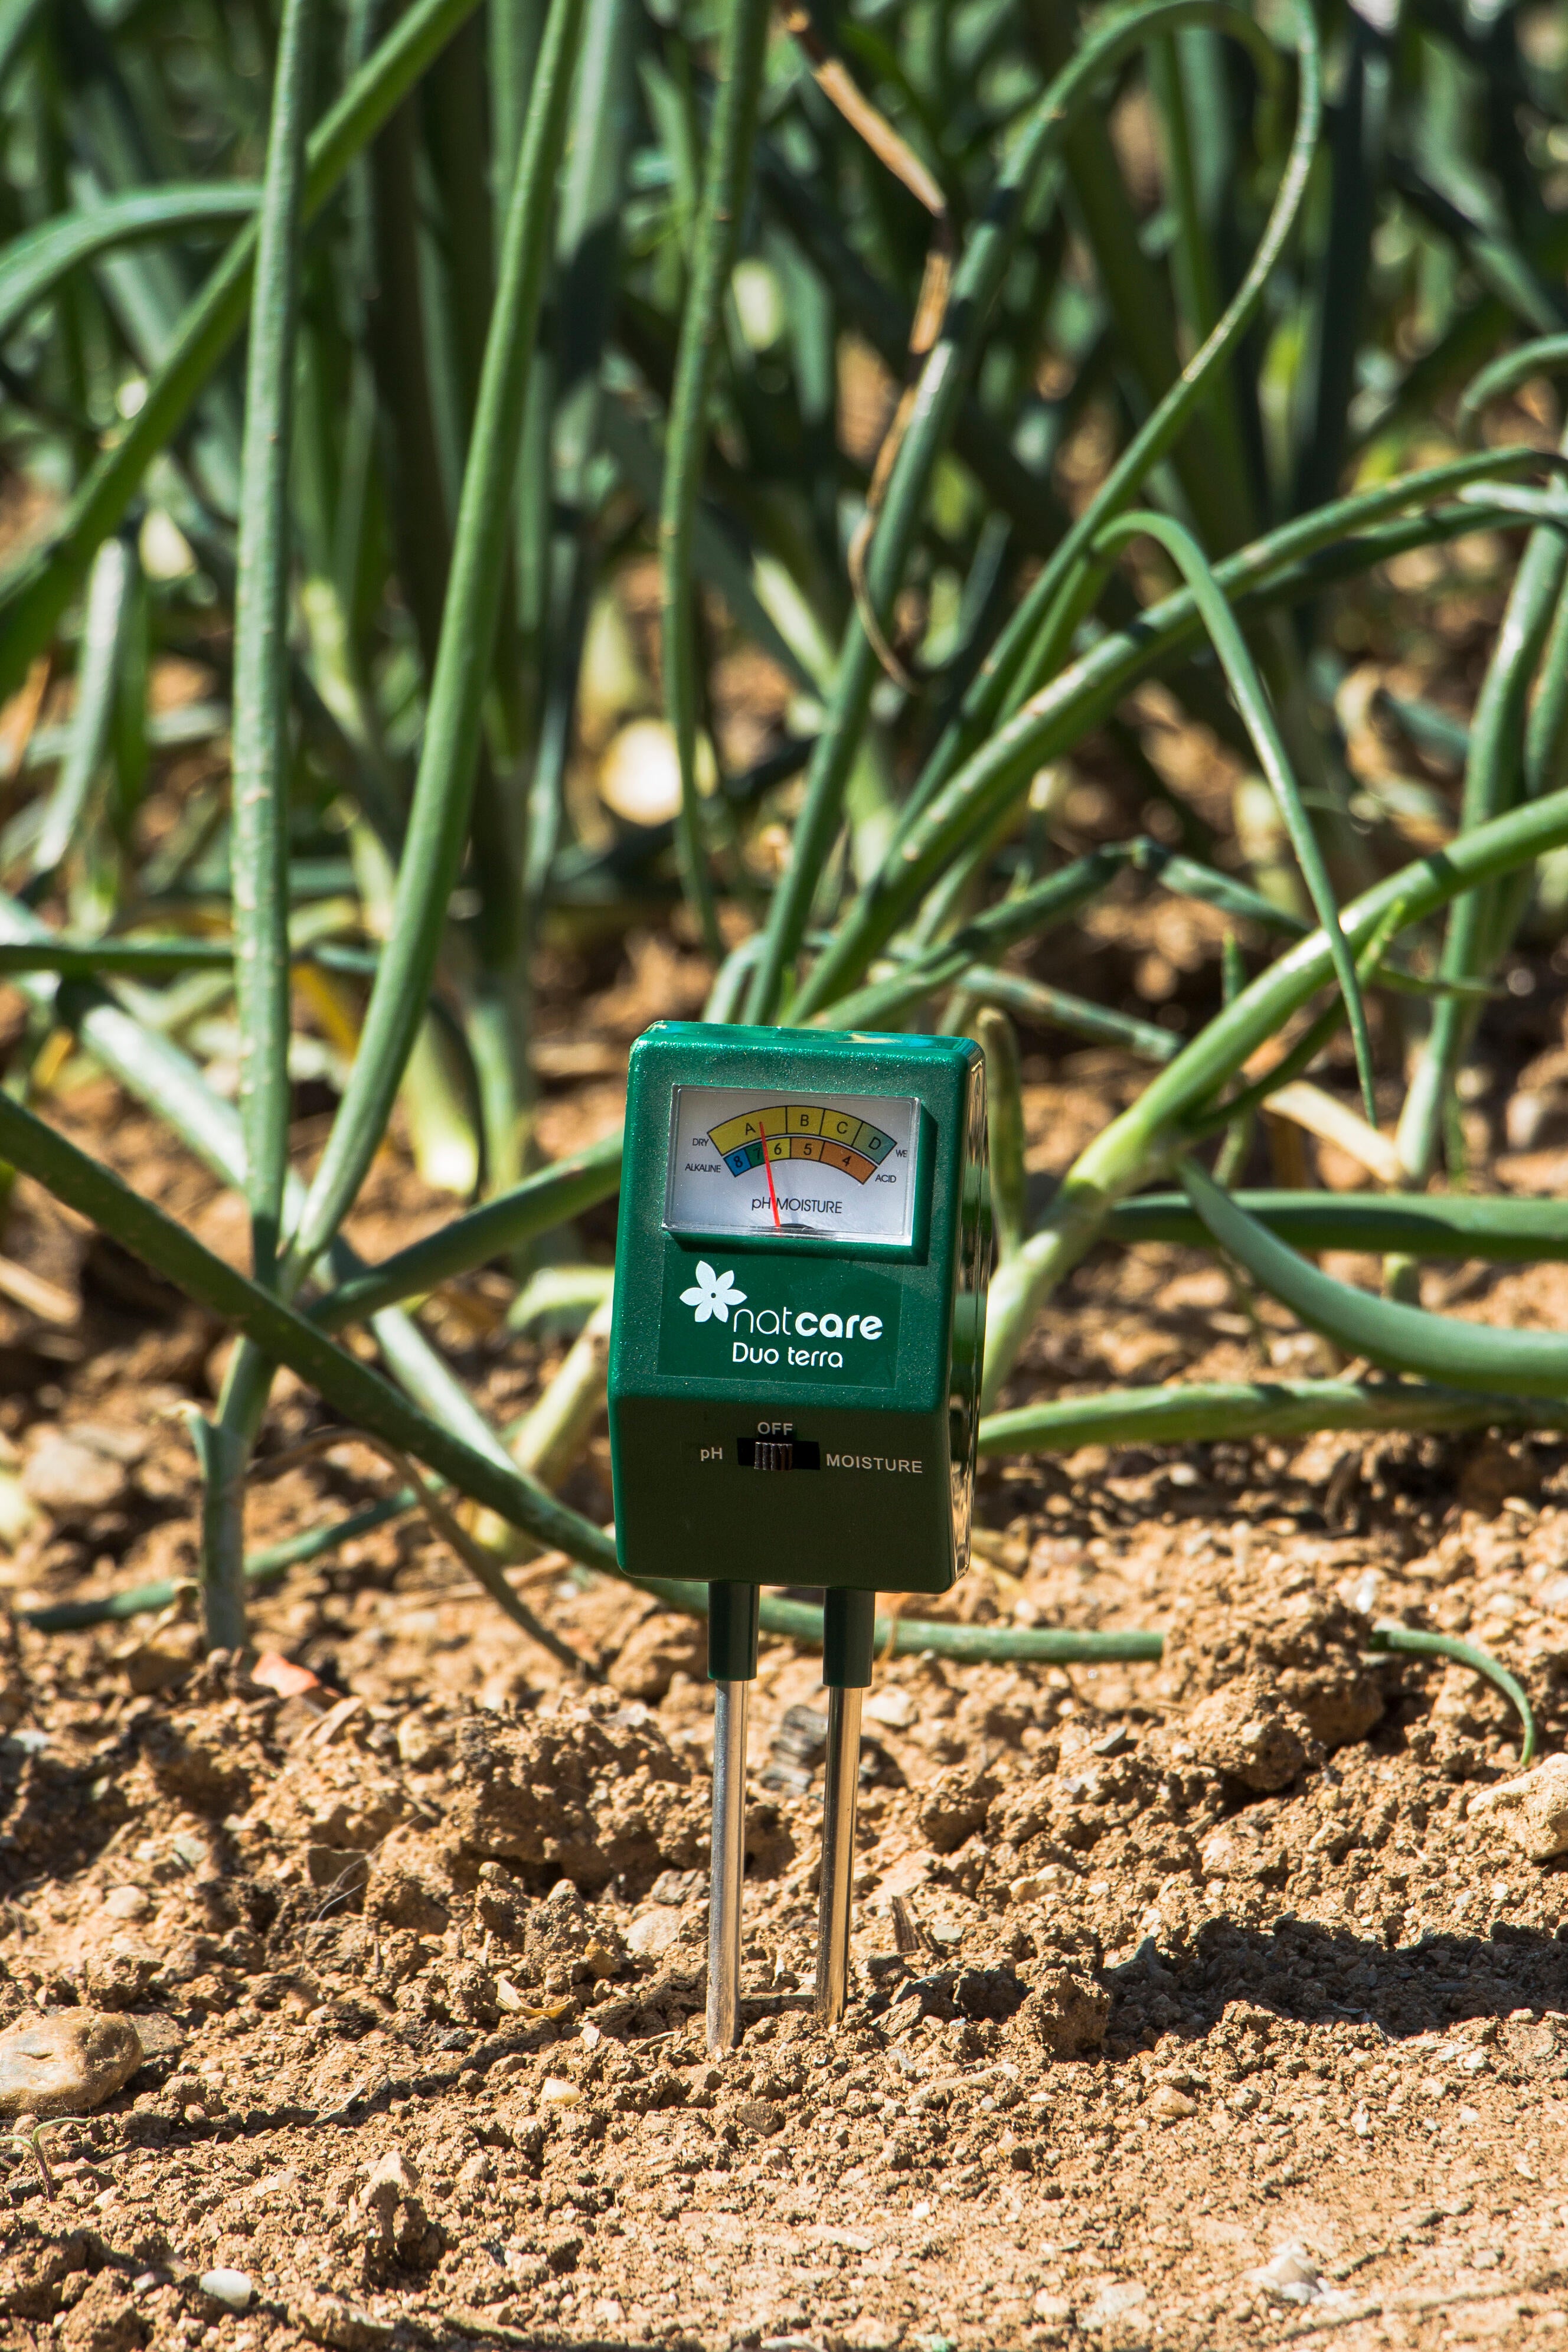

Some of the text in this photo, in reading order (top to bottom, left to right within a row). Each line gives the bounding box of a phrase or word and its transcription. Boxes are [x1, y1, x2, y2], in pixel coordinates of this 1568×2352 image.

[745, 1115, 881, 1150] A B C D
[692, 1138, 709, 1146] DRY
[733, 1142, 851, 1168] 8 7 6 5 4
[896, 1149, 908, 1158] WE
[685, 1163, 721, 1172] ALKALINE
[875, 1174, 897, 1183] ACID
[752, 1197, 842, 1214] pH MOISTURE
[733, 1306, 883, 1340] natcare
[732, 1342, 843, 1368] Duo terra
[757, 1422, 793, 1435] OFF
[700, 1447, 723, 1461] pH
[827, 1453, 923, 1474] MOISTURE
